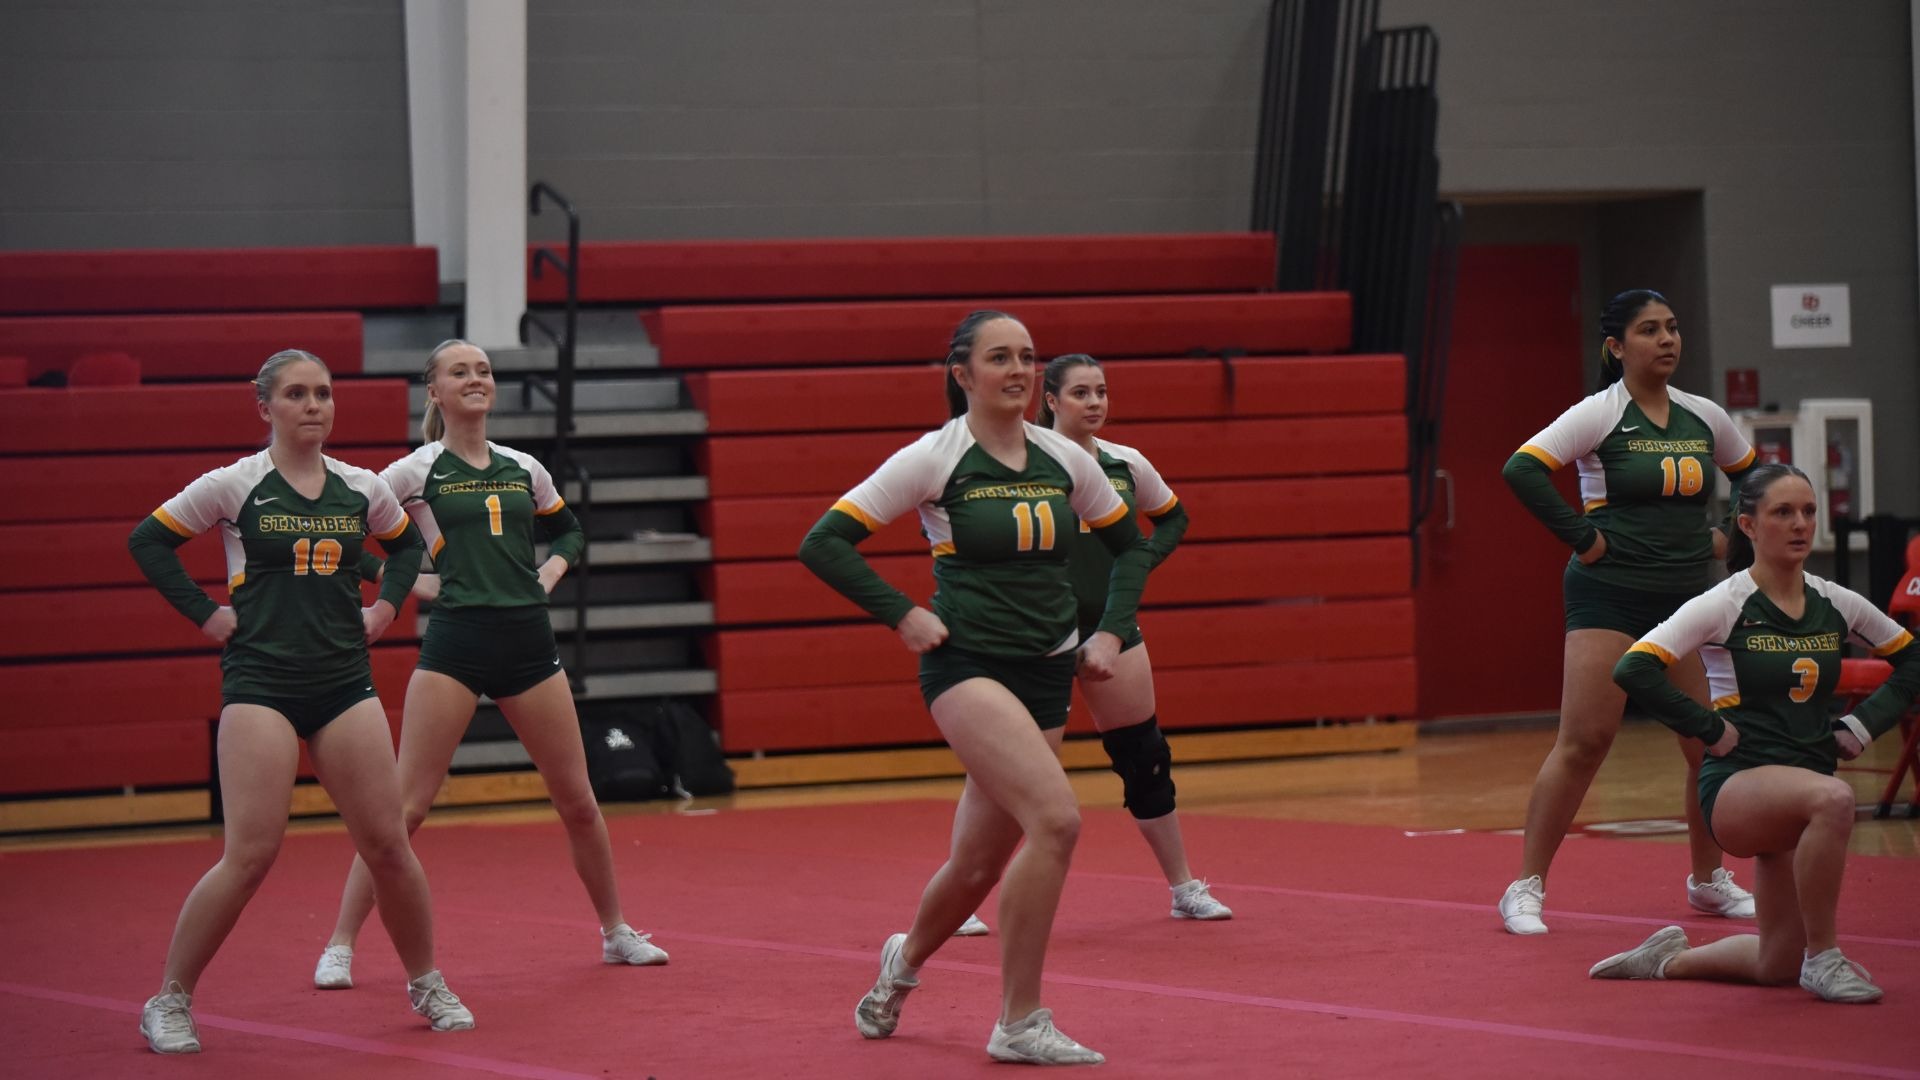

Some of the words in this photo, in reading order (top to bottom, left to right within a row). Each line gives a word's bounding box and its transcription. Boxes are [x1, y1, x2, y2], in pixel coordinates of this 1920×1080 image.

[1661, 456, 1704, 496] 18
[485, 495, 503, 536] 1
[1012, 501, 1055, 551] 11
[293, 538, 342, 576] 10
[1789, 657, 1819, 703] 3
